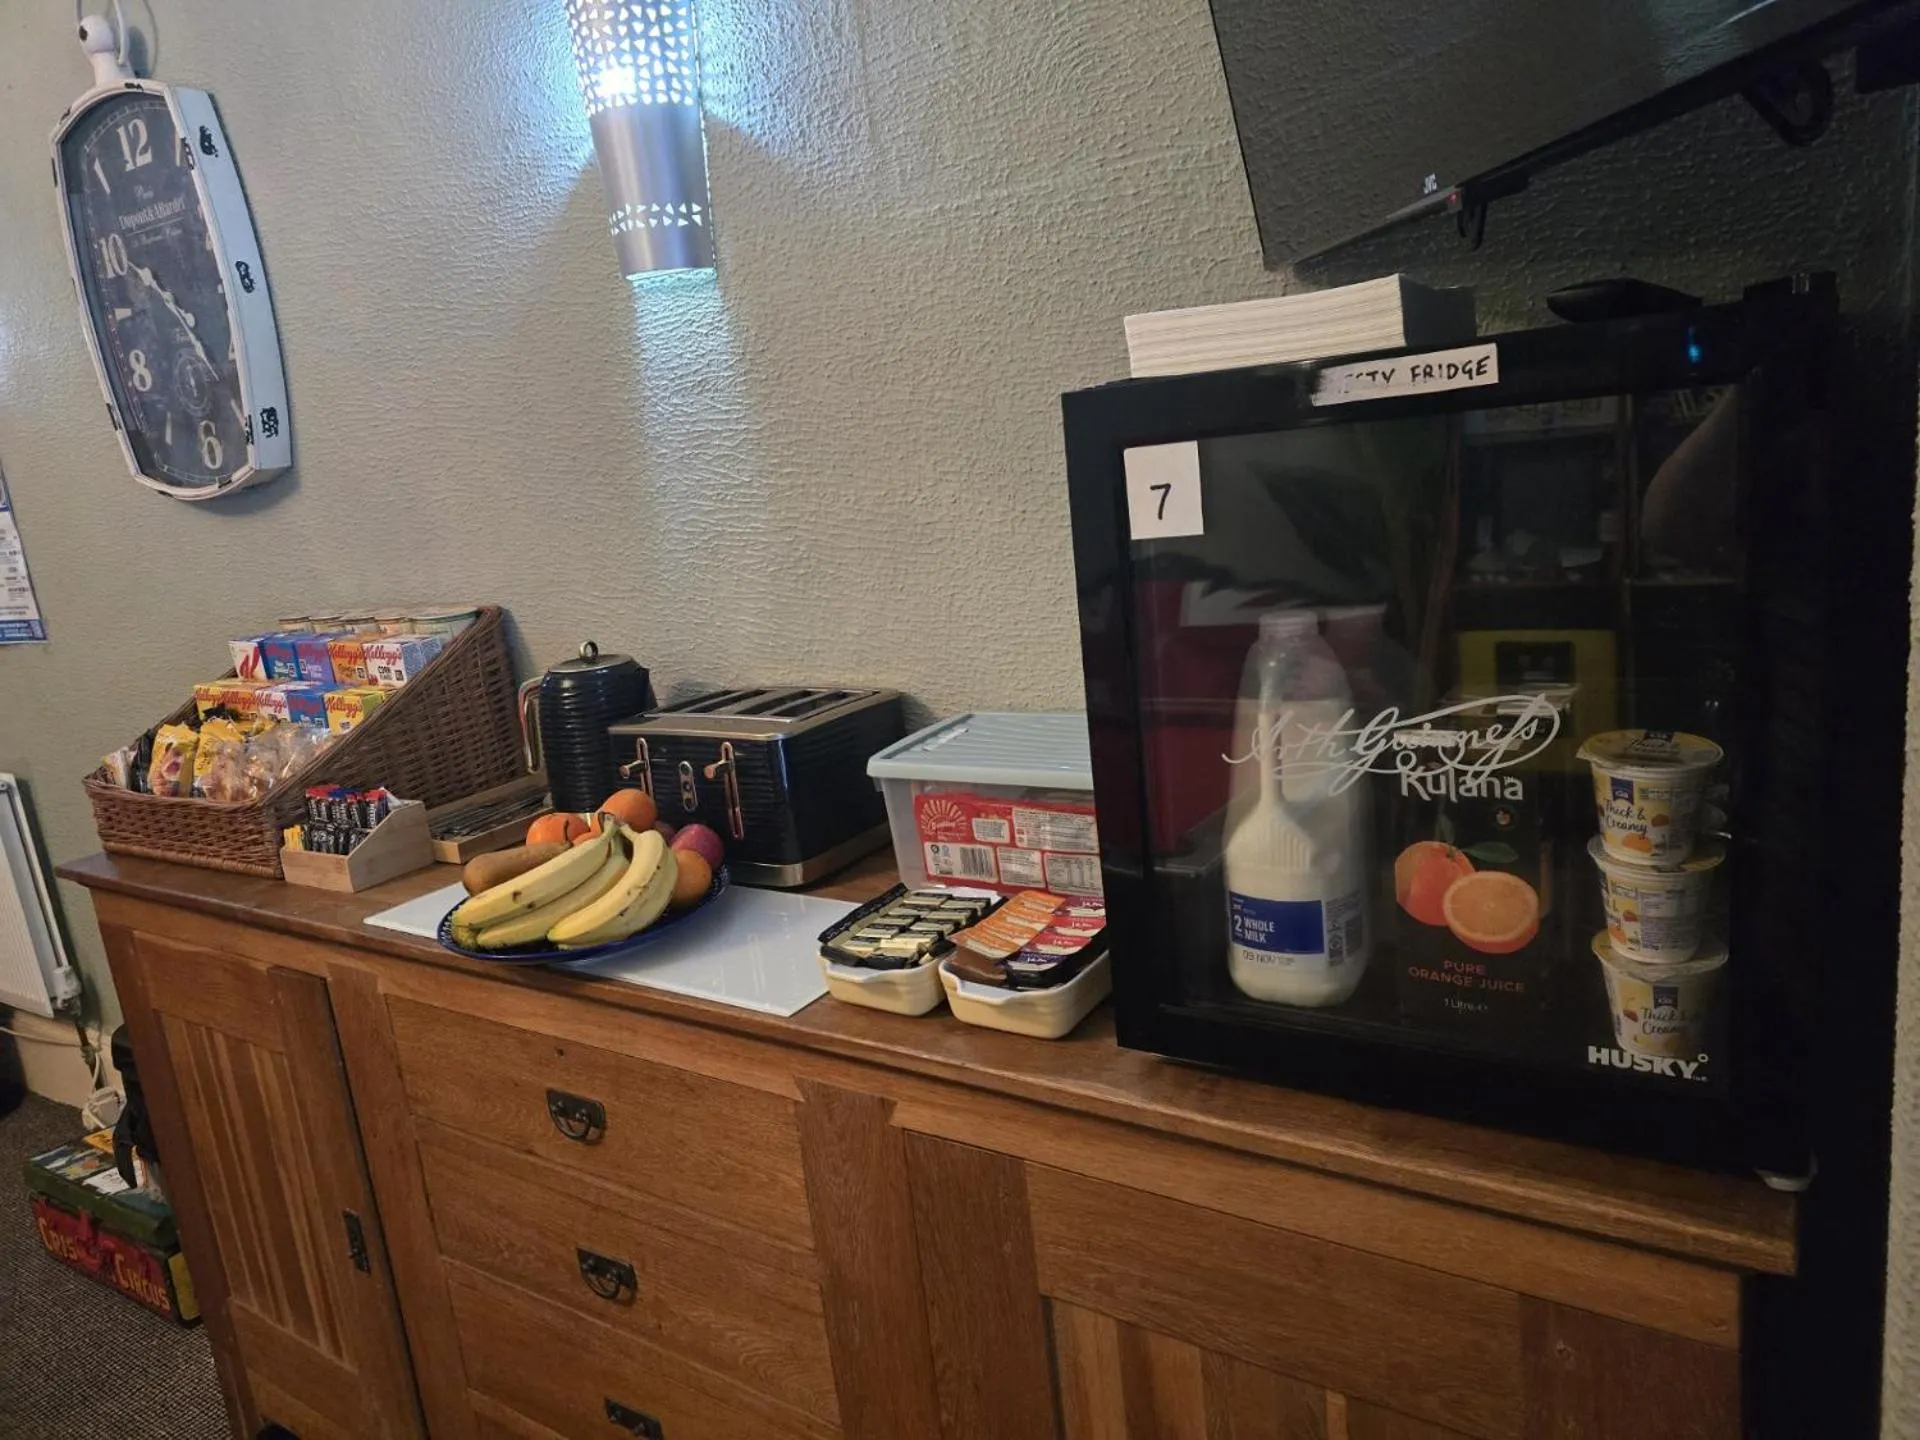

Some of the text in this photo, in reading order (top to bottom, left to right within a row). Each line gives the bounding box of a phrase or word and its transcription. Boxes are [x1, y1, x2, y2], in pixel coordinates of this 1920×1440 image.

[116, 118, 153, 172] 12
[100, 233, 128, 279] 10
[127, 349, 152, 392] 8
[1410, 355, 1491, 383] FRIDGE
[199, 420, 223, 470] 6
[1150, 483, 1172, 520] 7
[363, 644, 402, 666] Kellogg's
[325, 695, 363, 719] Kellogg's
[1233, 914, 1276, 933] 2 WHOLE
[1244, 928, 1268, 943] MILK
[1408, 966, 1526, 993] ORANGE JUICE
[1443, 960, 1486, 975] PURE
[1587, 1045, 1699, 1080] HUSKY
